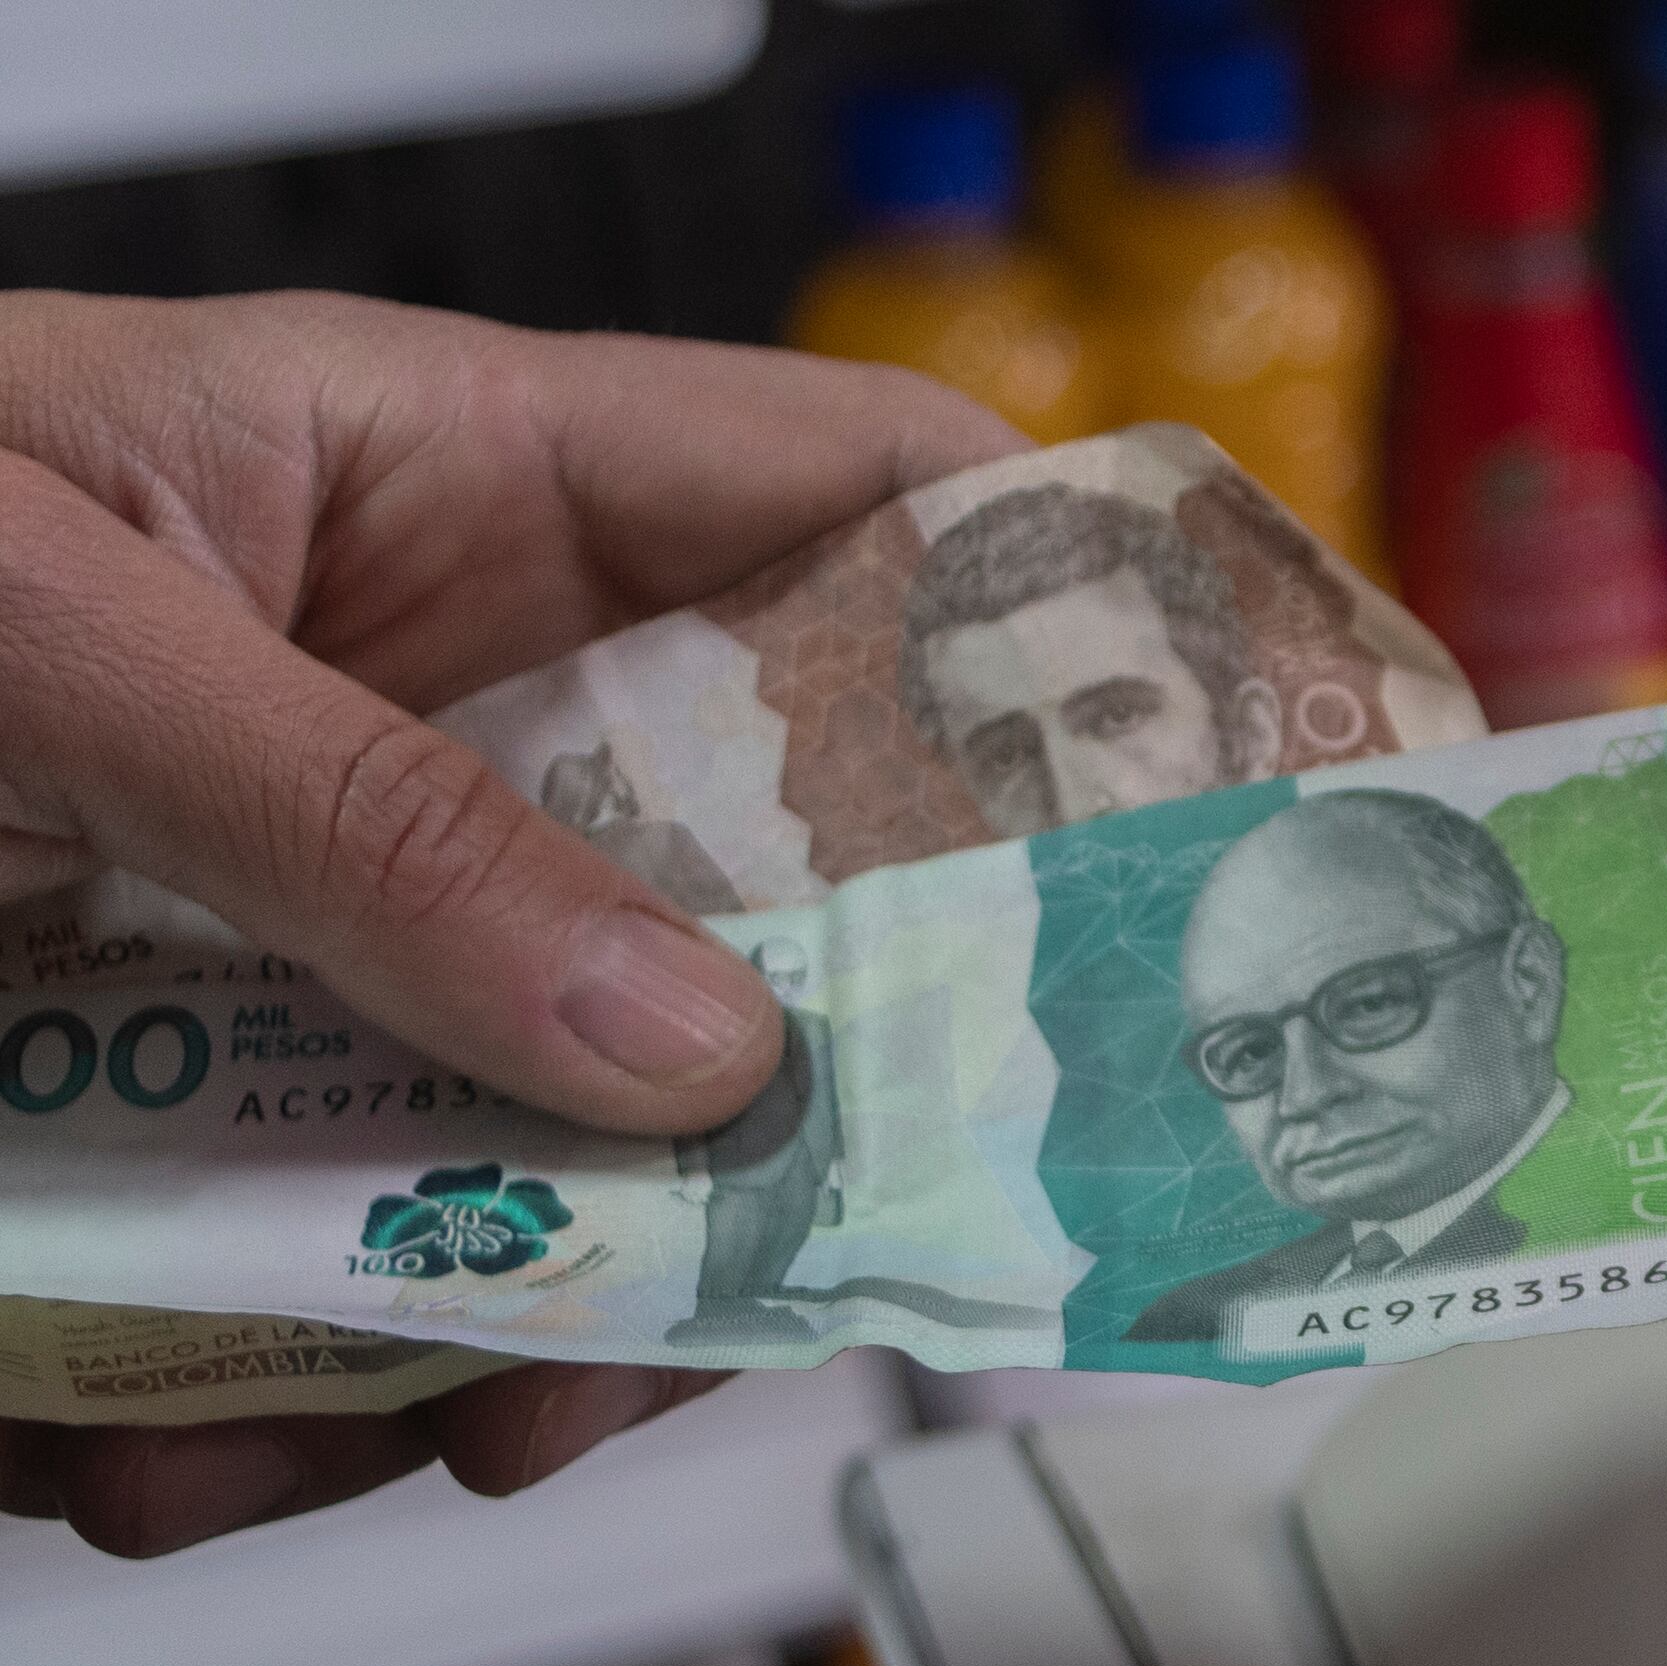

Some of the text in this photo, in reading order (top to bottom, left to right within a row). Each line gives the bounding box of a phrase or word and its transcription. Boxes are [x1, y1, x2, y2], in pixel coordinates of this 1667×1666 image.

[232, 1004, 296, 1032] MIL
[1616, 1010, 1647, 1071] MIL
[230, 1030, 353, 1062] PESOS
[65, 1339, 200, 1374] BANCO
[211, 1324, 253, 1351] DE
[272, 1319, 318, 1342] LA
[74, 1347, 347, 1398] COLOMBIA
